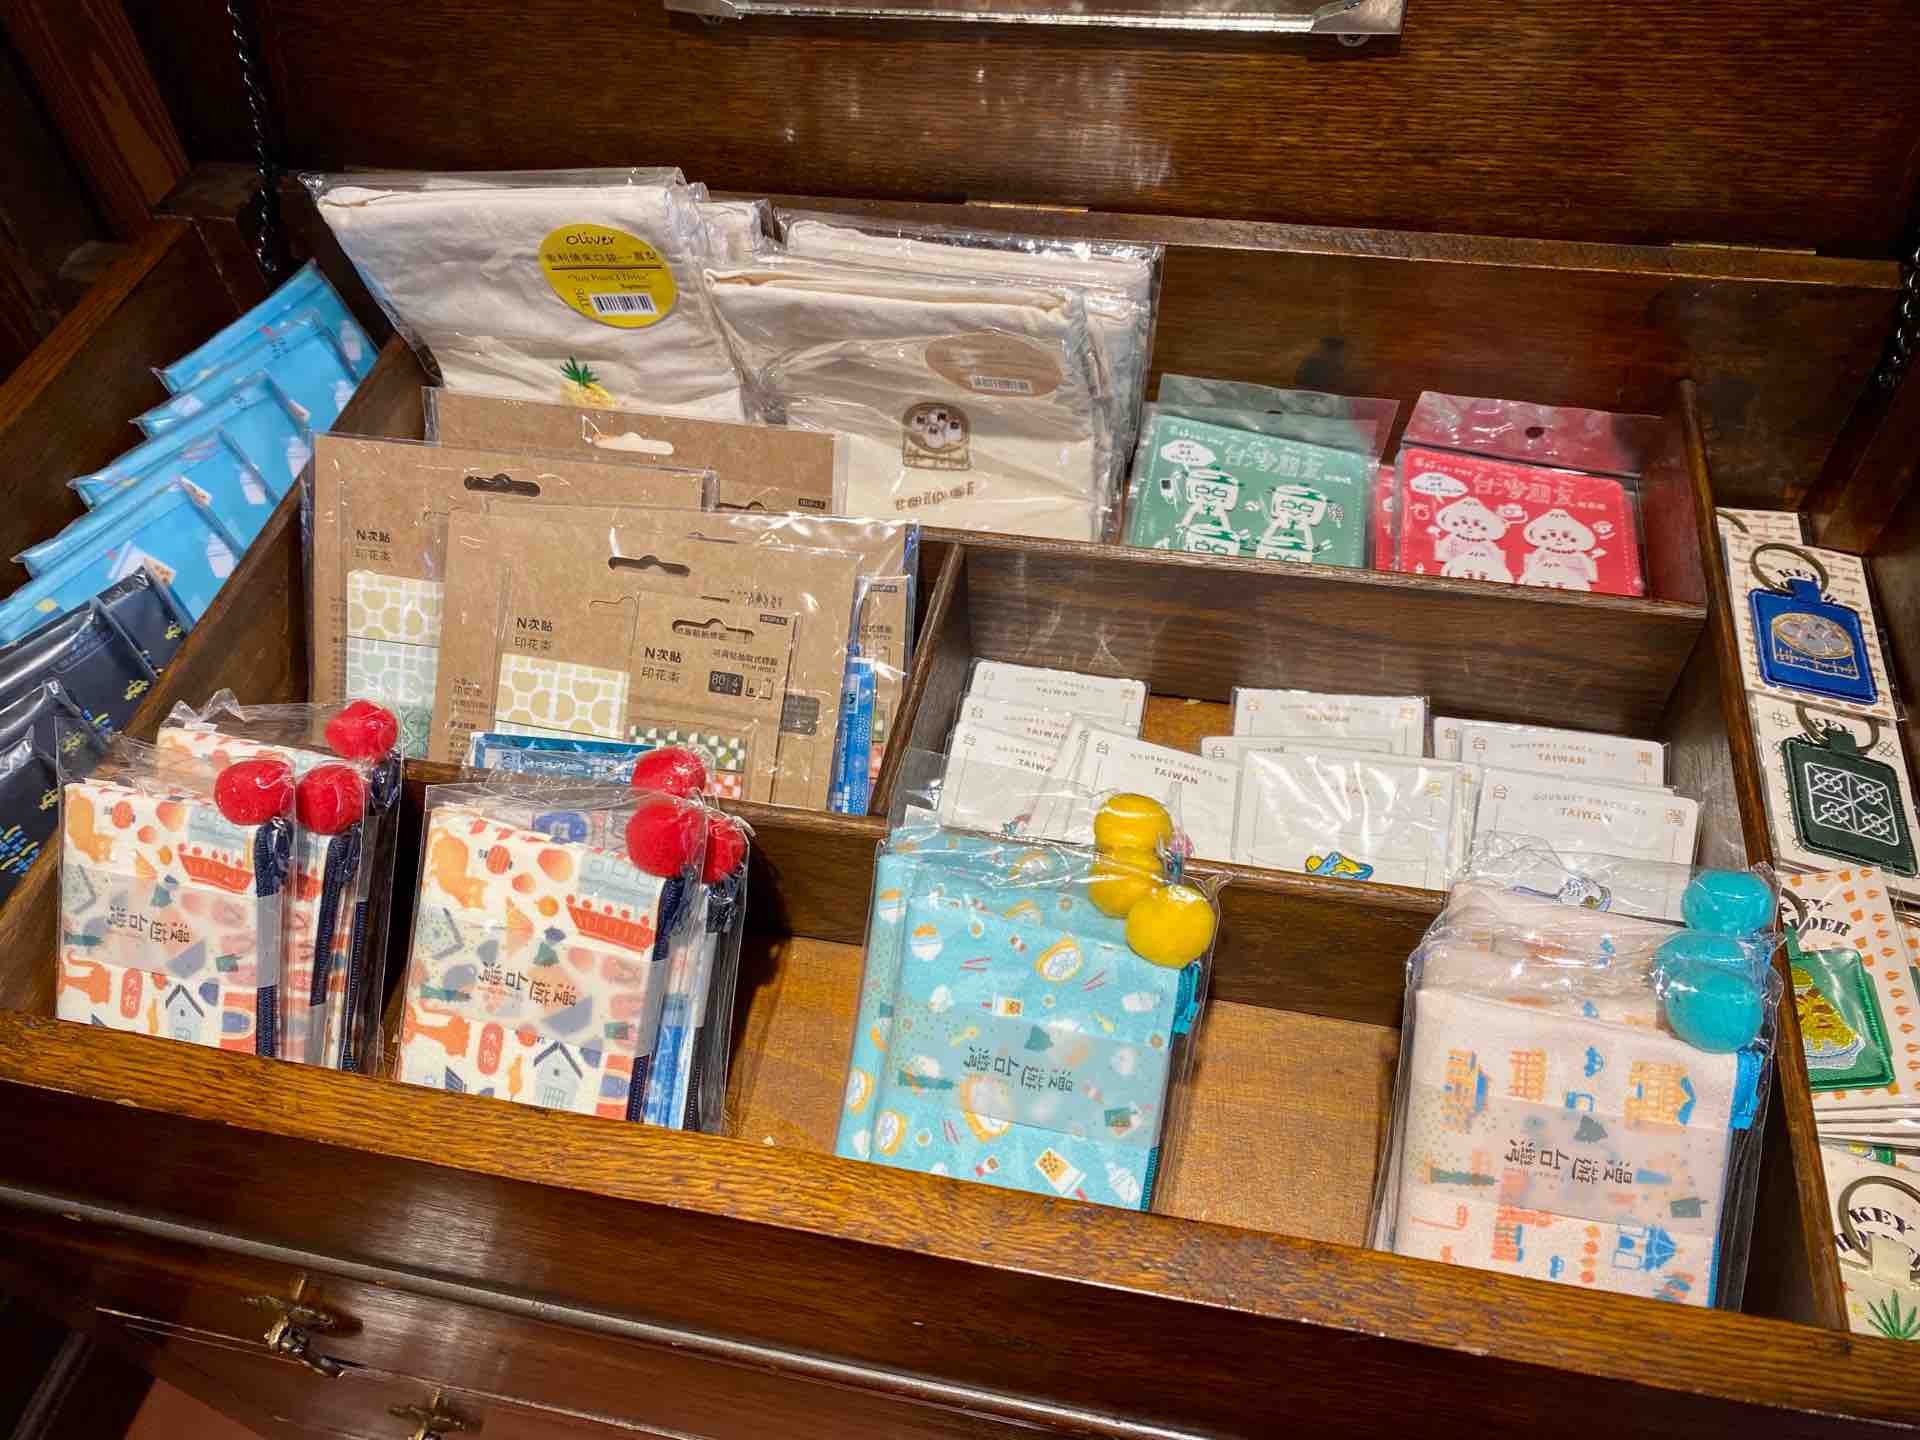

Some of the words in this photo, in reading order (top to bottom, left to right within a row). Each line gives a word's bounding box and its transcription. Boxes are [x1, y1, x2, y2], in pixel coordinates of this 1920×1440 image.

[565, 231, 616, 246] Oliver
[356, 529, 391, 543] N次貼
[517, 617, 553, 632] N次貼
[644, 647, 682, 663] N次貼
[1036, 686, 1078, 698] TAIWAN
[1536, 753, 1586, 766] TAIWAN
[1153, 767, 1199, 785] TAIWAN
[1560, 807, 1614, 825] TAIWAN
[478, 960, 577, 1008] 漫遊台灣
[963, 1045, 1073, 1093] 漫遊台灣
[1504, 1138, 1633, 1185] 漫遊台灣
[1848, 1206, 1916, 1236] KEY
